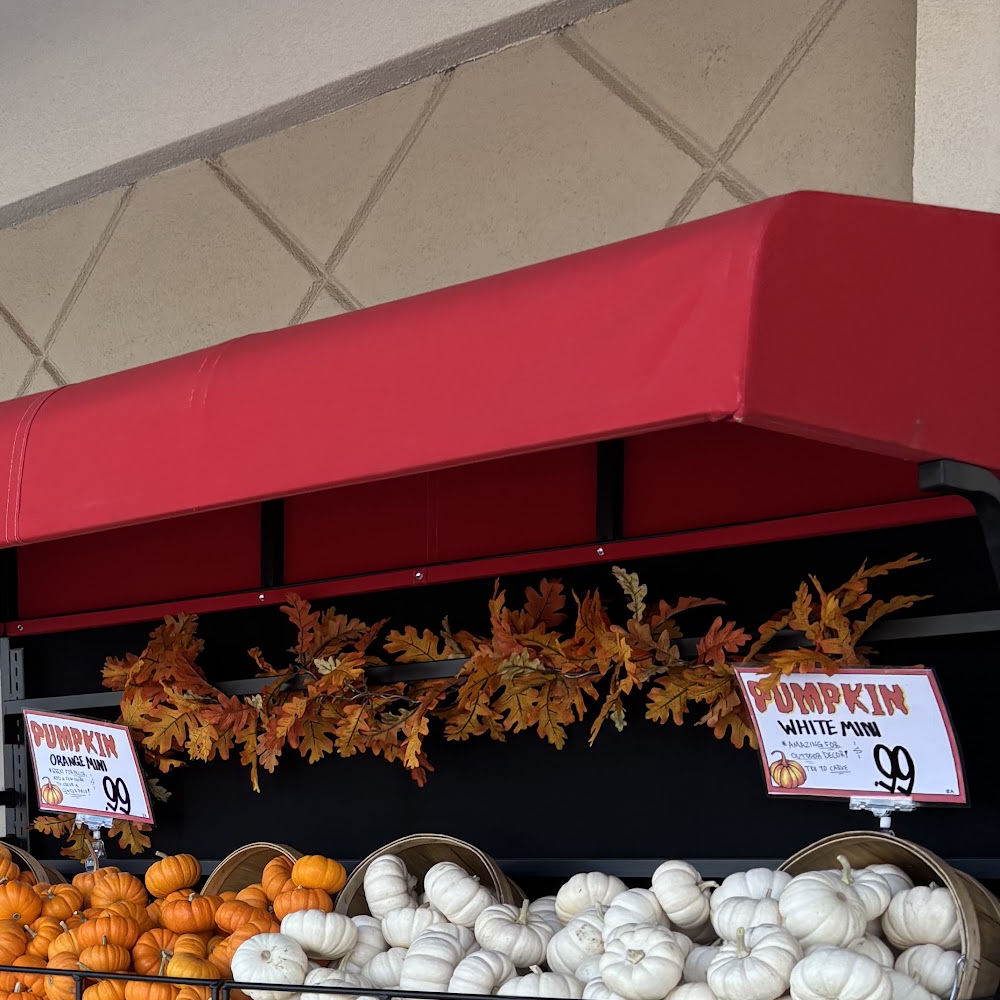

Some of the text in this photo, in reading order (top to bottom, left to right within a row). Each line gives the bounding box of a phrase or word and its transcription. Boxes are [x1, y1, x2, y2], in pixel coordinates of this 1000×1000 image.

[747, 681, 910, 716] PUMPKIN
[30, 720, 119, 759] PUMPKIN
[778, 720, 882, 737] WHITE MINI
[50, 754, 86, 767] ORANGE
[86, 756, 108, 772] MINI
